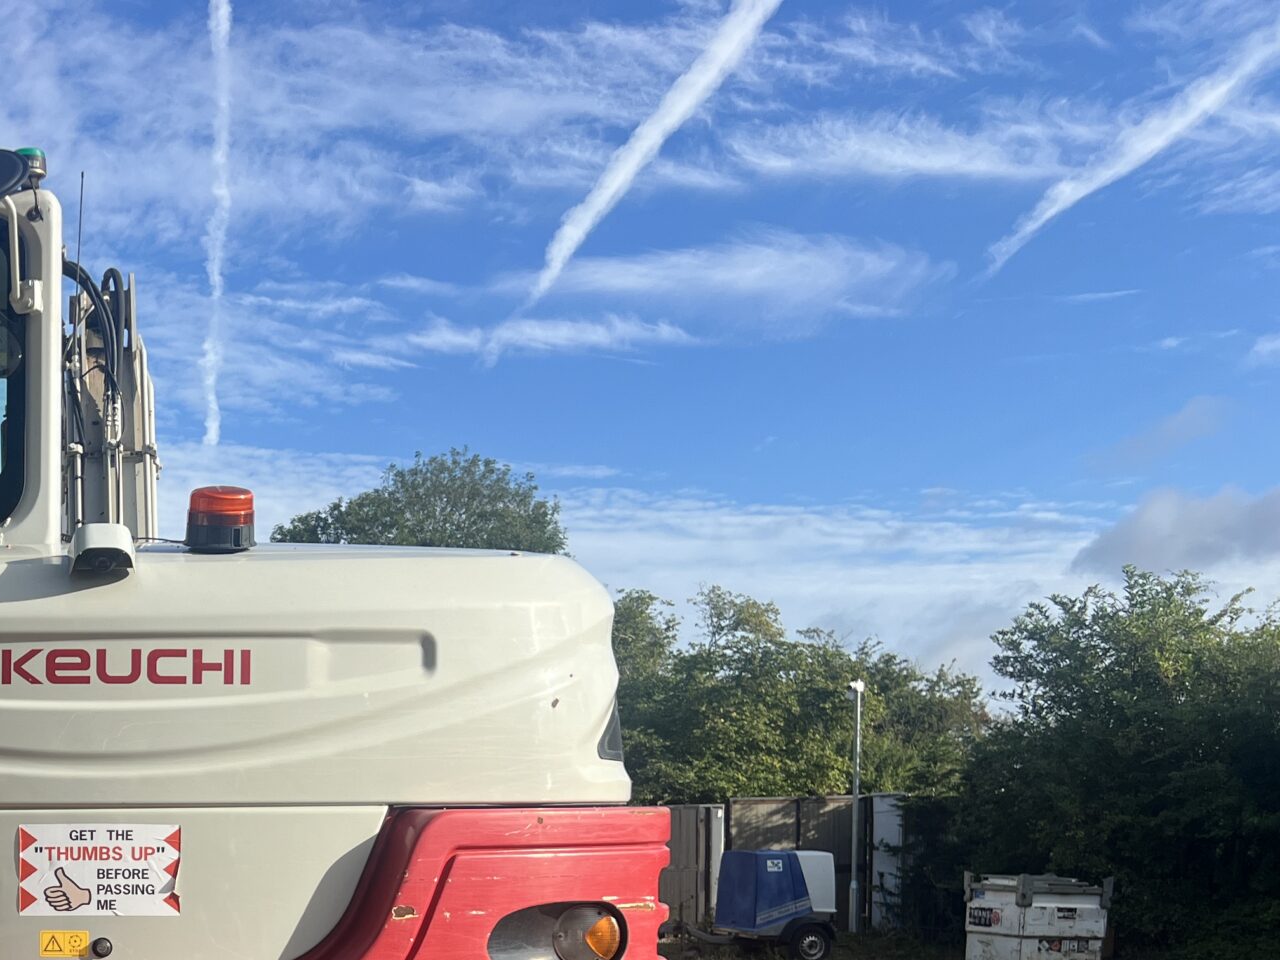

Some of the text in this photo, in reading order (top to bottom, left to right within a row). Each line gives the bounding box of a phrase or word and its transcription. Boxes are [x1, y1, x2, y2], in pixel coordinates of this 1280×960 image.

[69, 829, 133, 841] GET THE
[34, 846, 123, 861] "THUMBS
[96, 868, 150, 880] BEFORE
[96, 883, 155, 895] PASSING
[96, 899, 117, 911] ME
